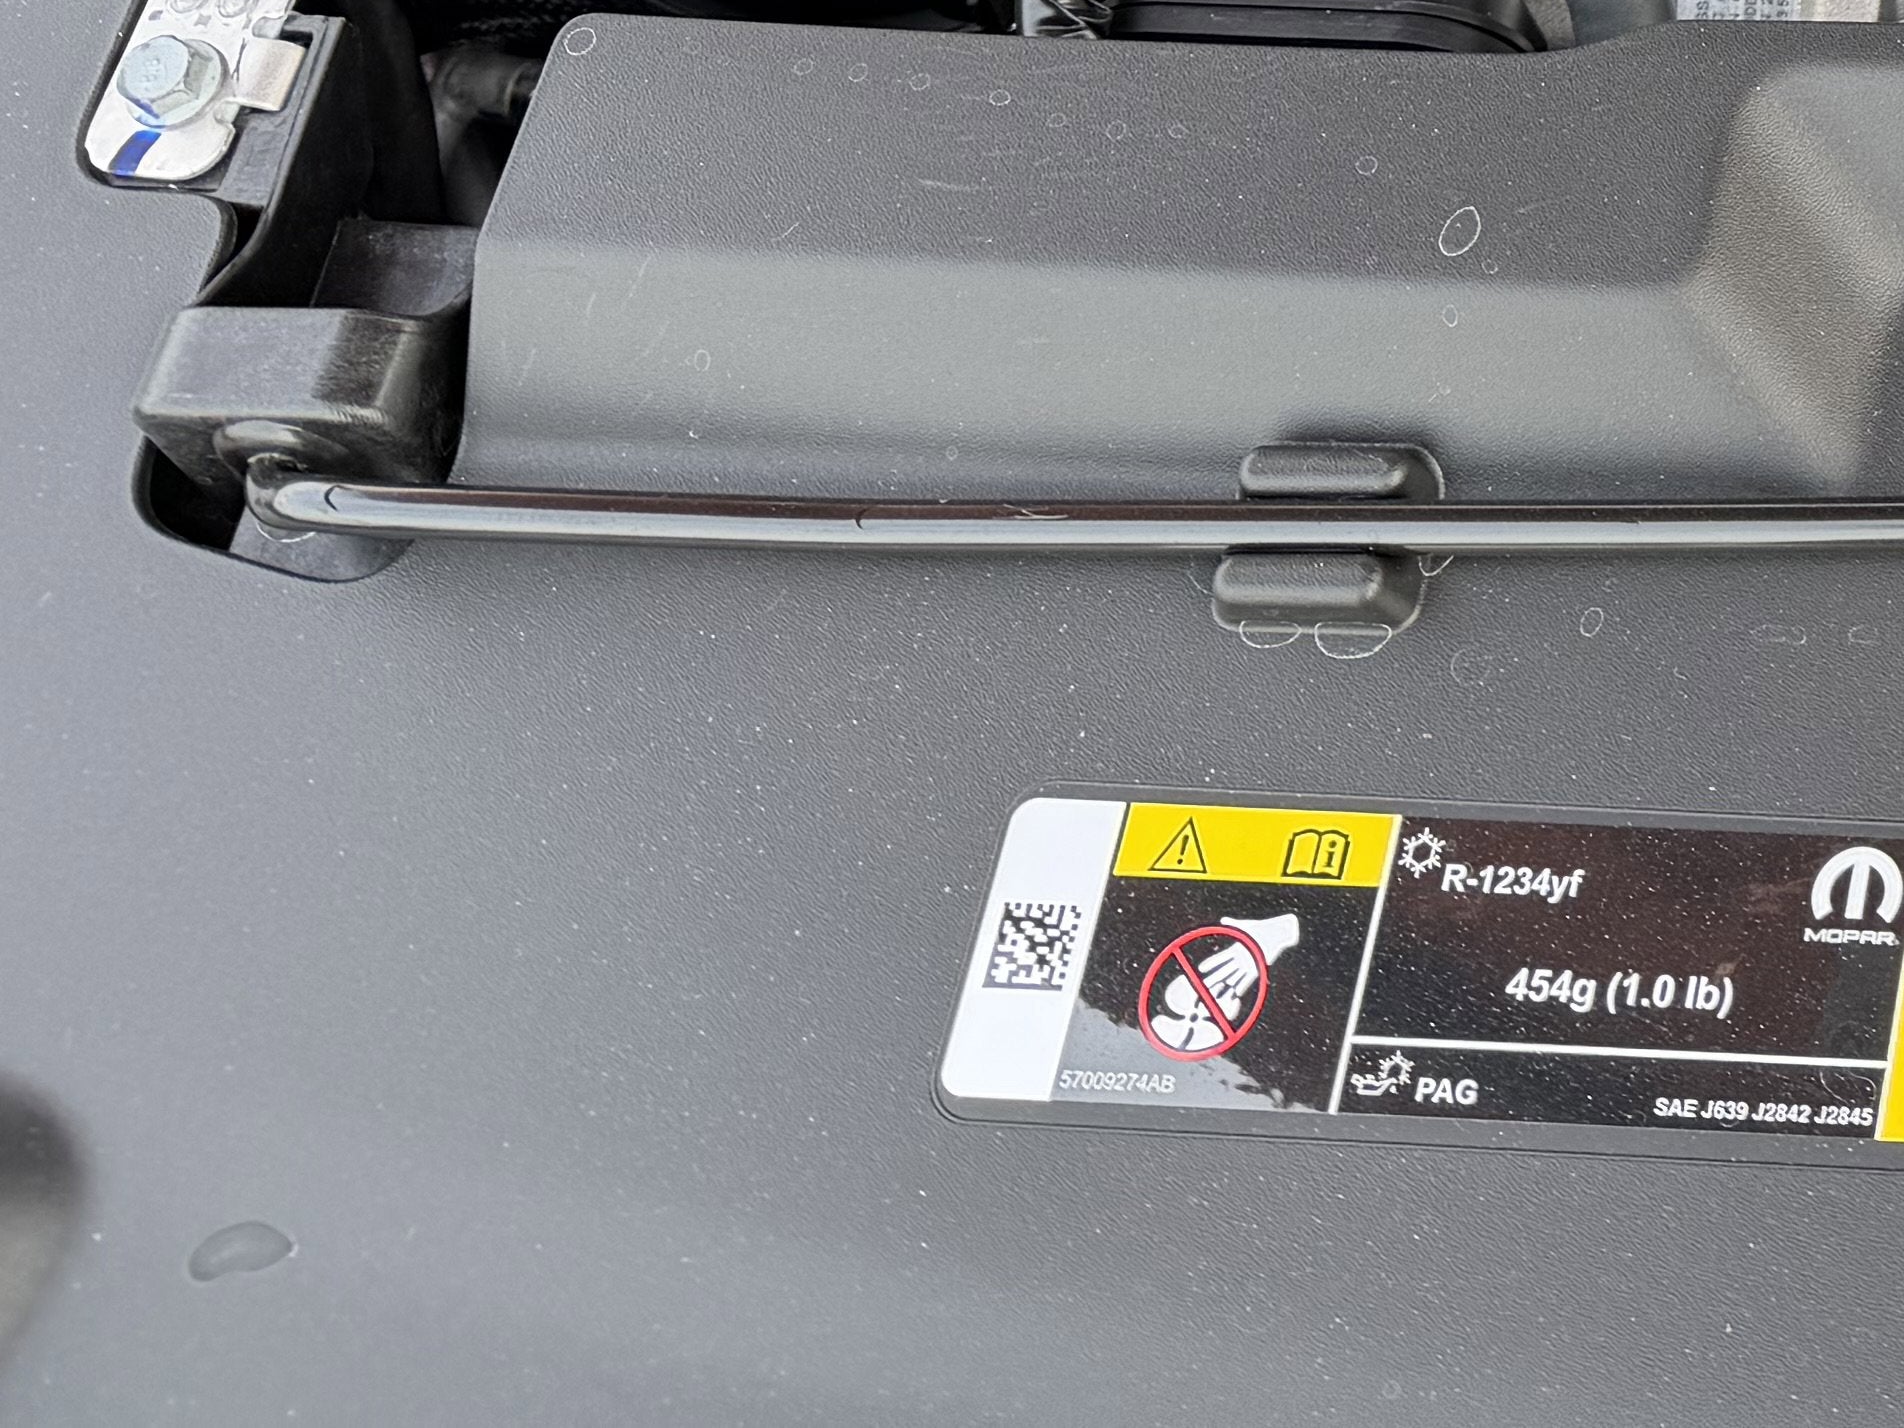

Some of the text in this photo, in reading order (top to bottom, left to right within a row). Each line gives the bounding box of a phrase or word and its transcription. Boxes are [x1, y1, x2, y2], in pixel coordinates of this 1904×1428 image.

[1440, 863, 1586, 904] R-1234yf
[1803, 927, 1897, 945] MOPAR
[1504, 967, 1736, 1020] 454g (1.0 lb)
[1059, 1069, 1177, 1093] 57009274AB
[1413, 1077, 1479, 1106] PAG
[1653, 1097, 1874, 1126] SAE J639 J2842 J2845
